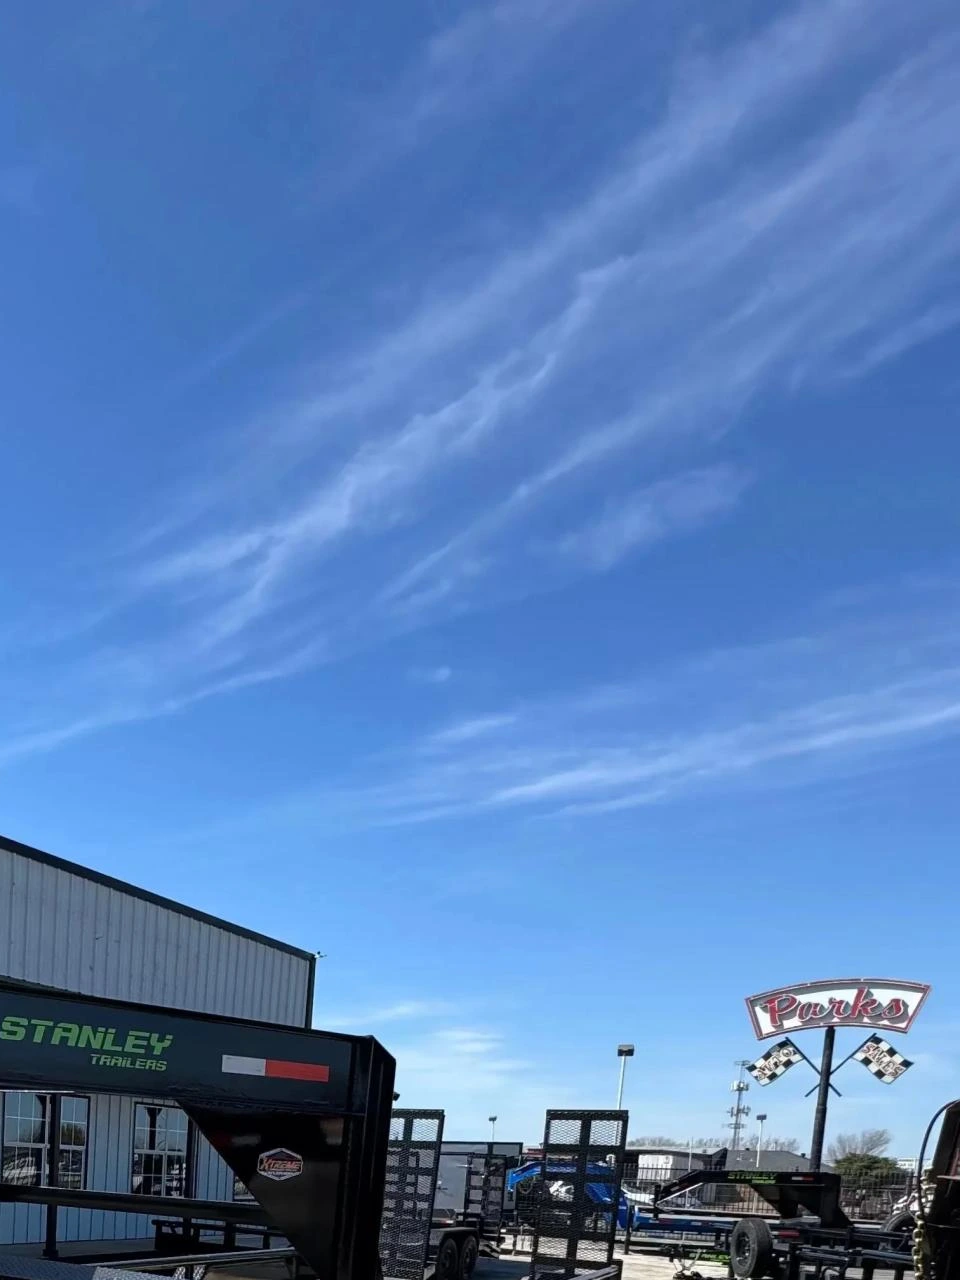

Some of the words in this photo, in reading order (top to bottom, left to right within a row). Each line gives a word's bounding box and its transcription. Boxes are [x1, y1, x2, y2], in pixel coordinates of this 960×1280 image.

[760, 986, 905, 1026] Parks
[0, 1016, 174, 1056] STANLEY
[89, 1053, 168, 1072] TRAILERS
[861, 1043, 906, 1078] SALES
